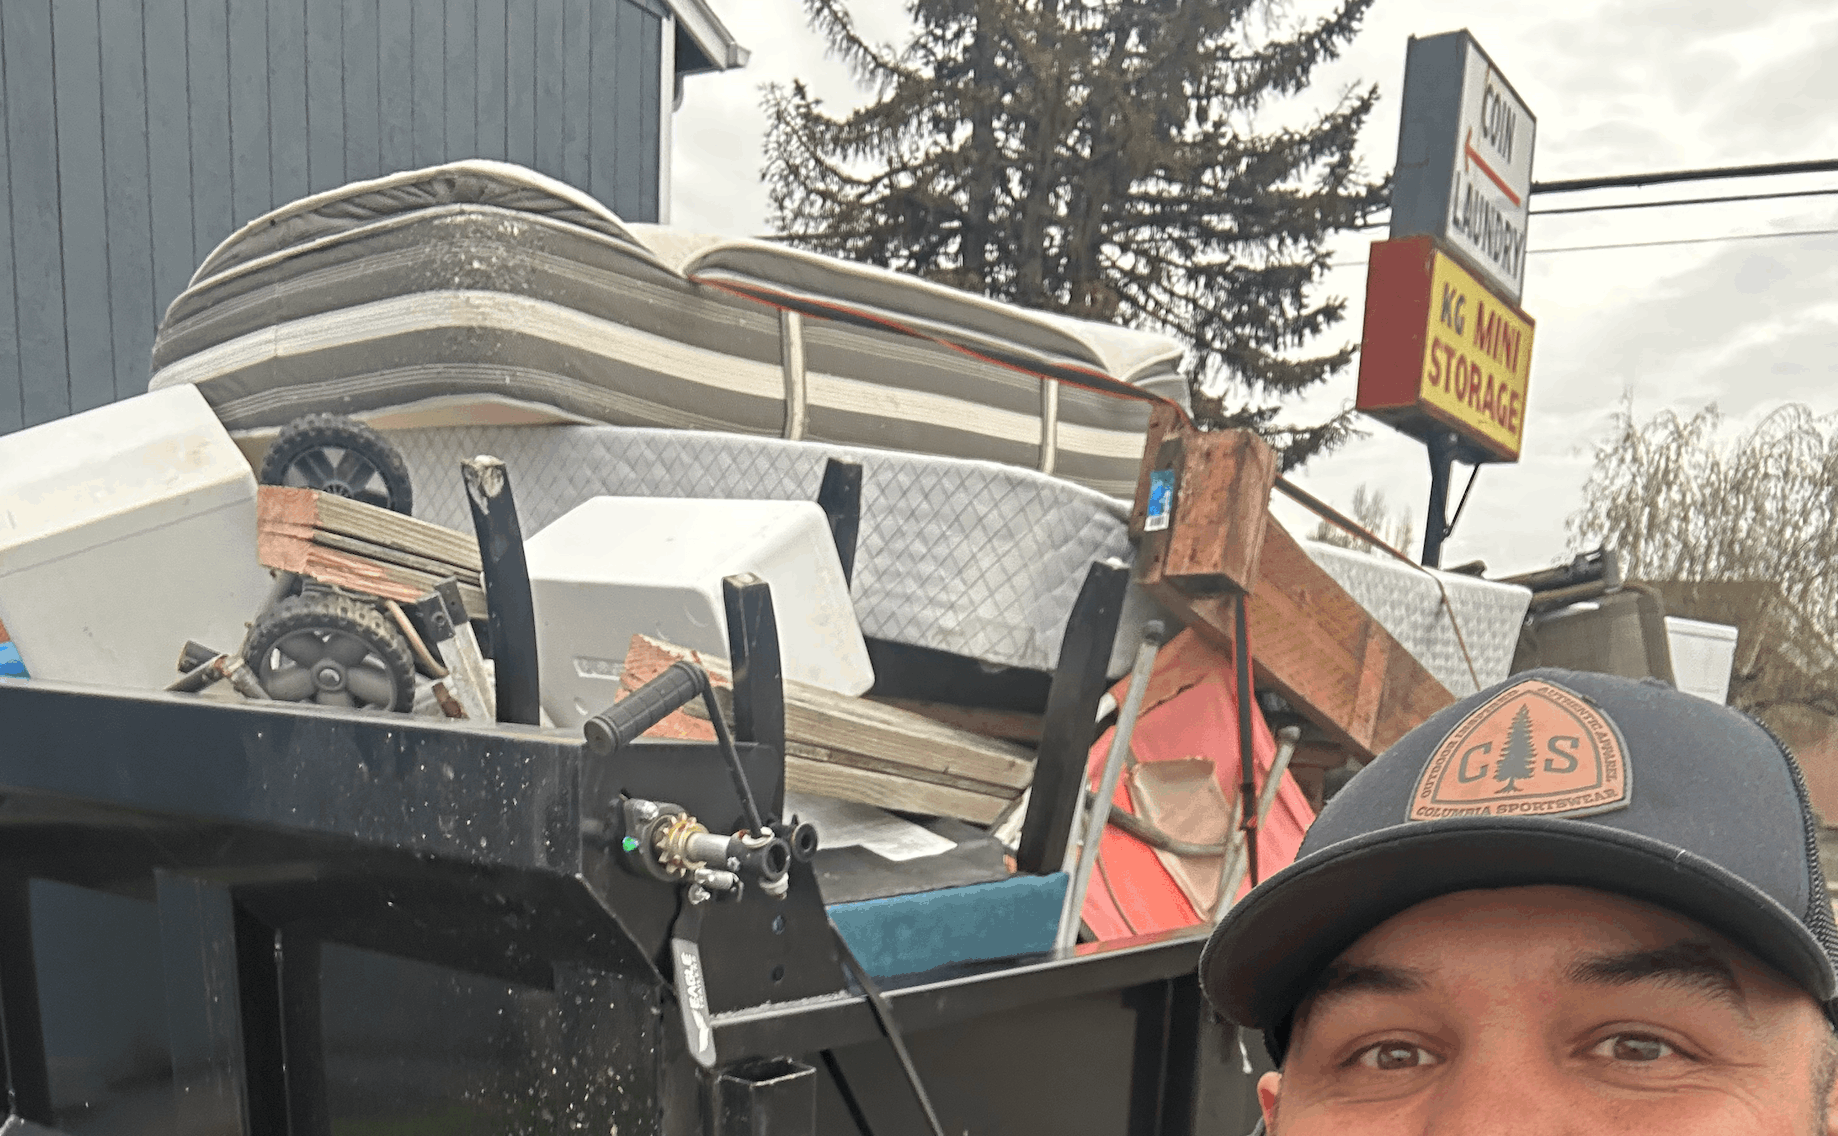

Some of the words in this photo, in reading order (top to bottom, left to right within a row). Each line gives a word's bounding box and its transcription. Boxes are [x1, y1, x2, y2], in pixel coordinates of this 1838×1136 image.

[1481, 84, 1517, 165] COIN
[1453, 171, 1525, 280] LAUNDRY
[1440, 282, 1466, 336] KG
[1474, 300, 1521, 374] MINI
[1428, 336, 1519, 434] STORAGE
[1538, 686, 1603, 730] AUTHENTIC
[1421, 740, 1458, 799] OUTDOOR
[1458, 741, 1493, 784] C
[1544, 735, 1580, 774] S
[1416, 806, 1491, 818] COLUMBIA
[1496, 788, 1619, 814] SPORTSWEAR
[681, 951, 701, 1010] EAGLE
